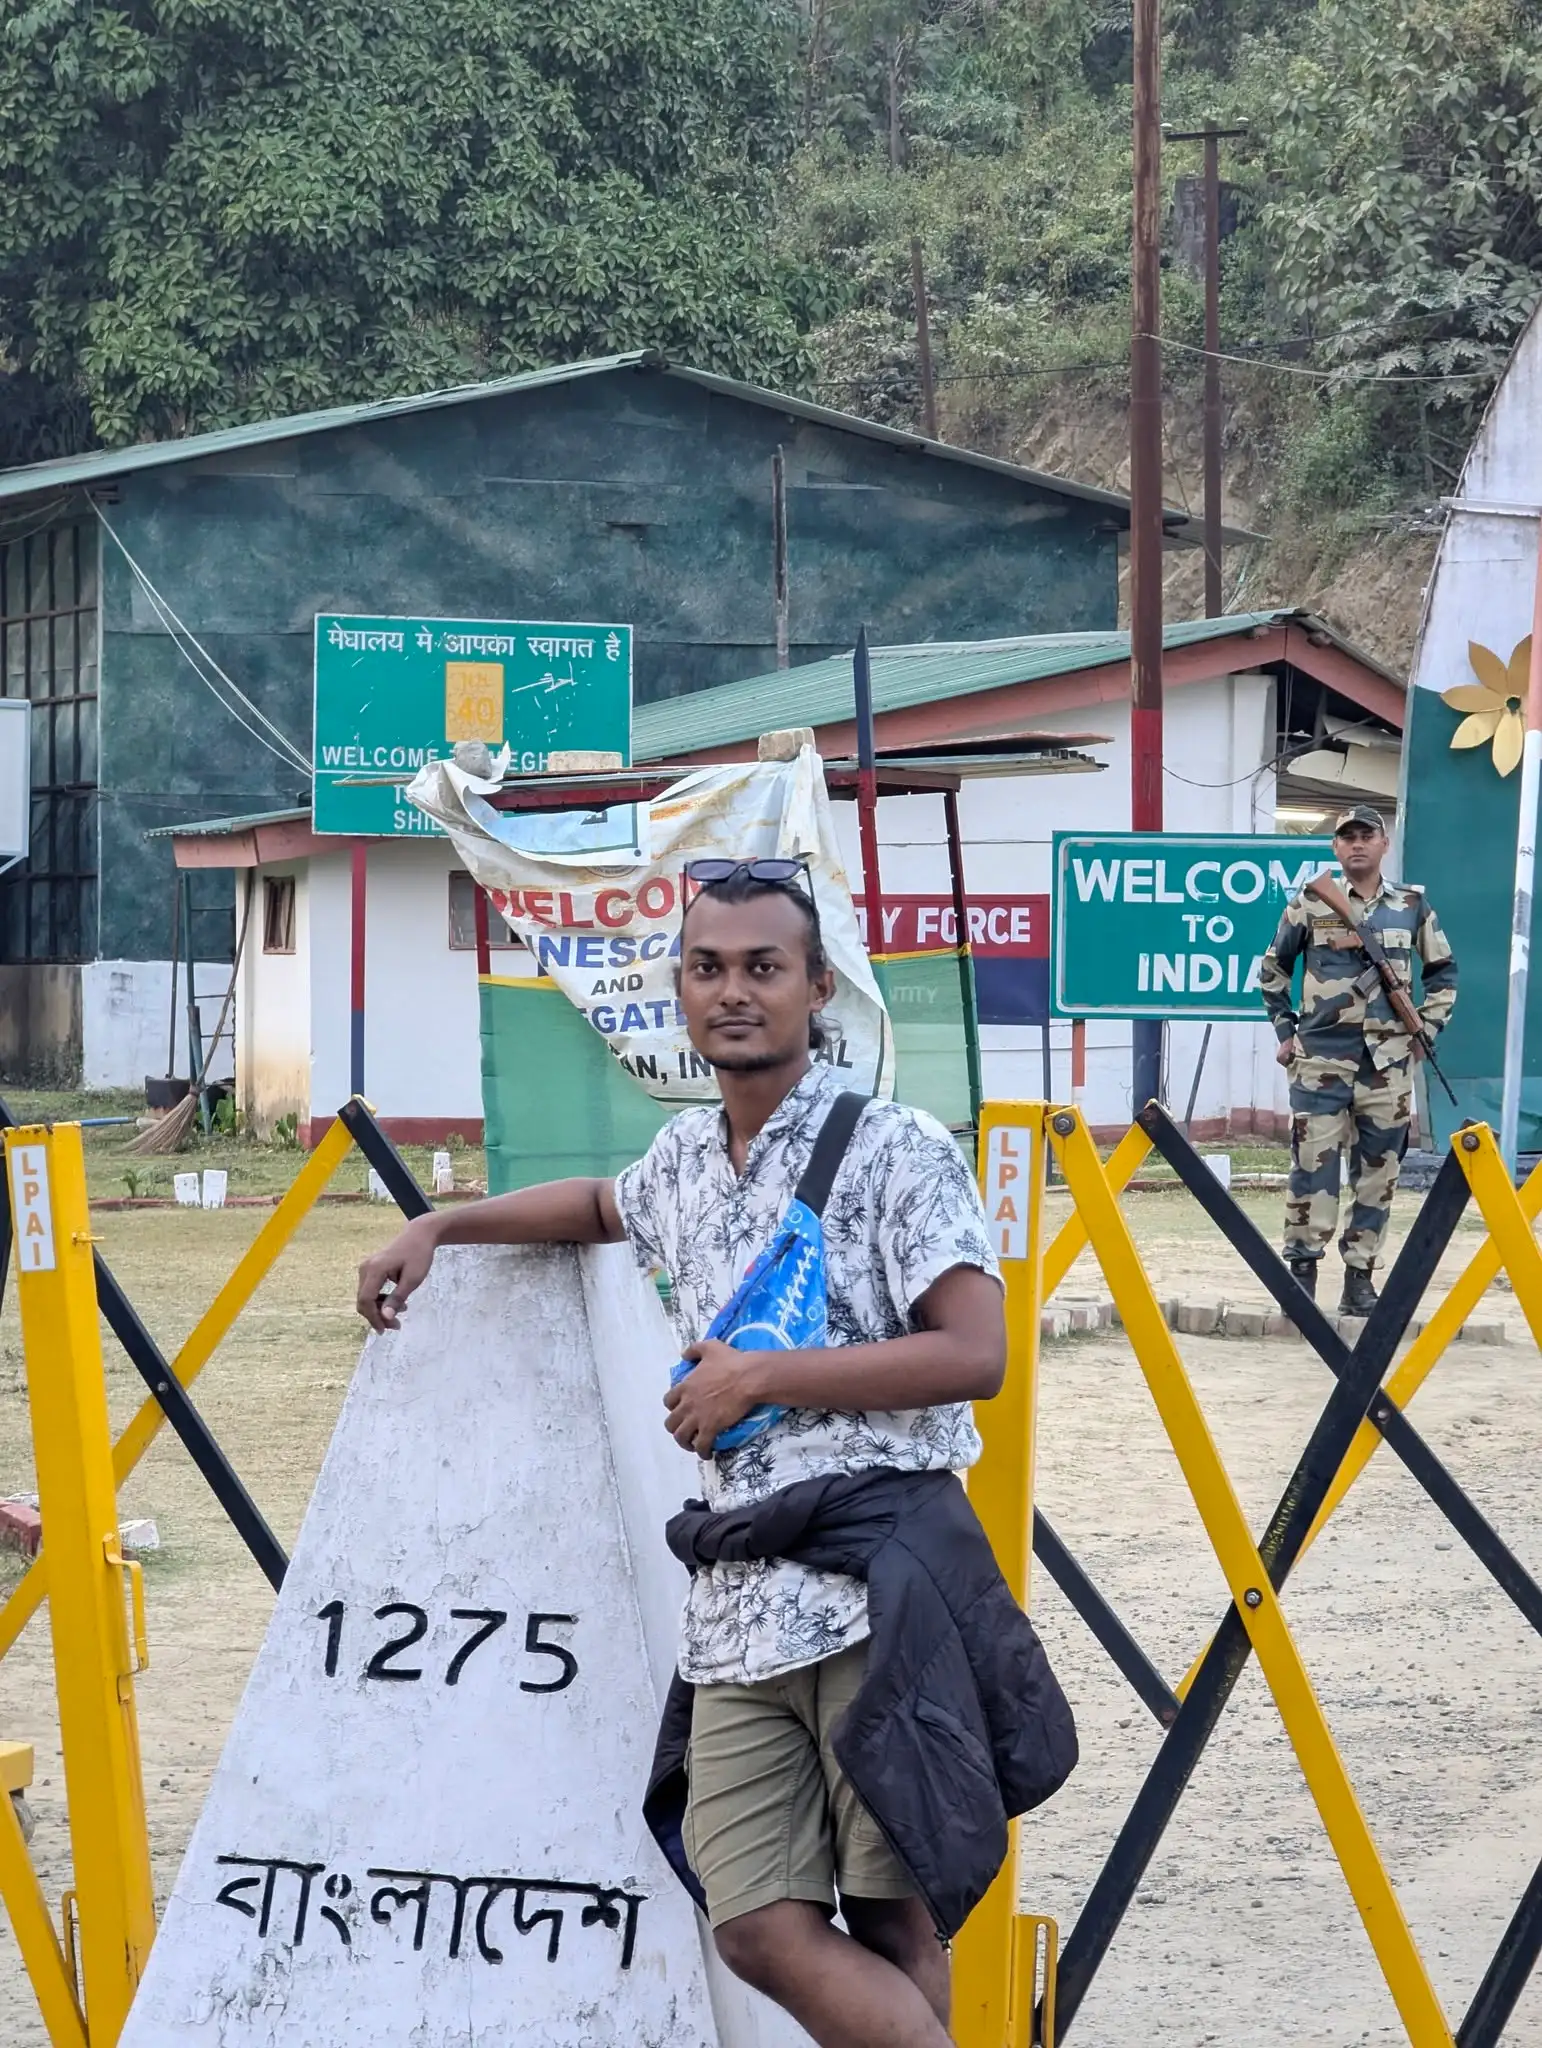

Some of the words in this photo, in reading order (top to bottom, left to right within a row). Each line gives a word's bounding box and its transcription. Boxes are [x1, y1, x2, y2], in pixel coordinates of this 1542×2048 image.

[527, 636, 596, 662] स्वागत
[605, 631, 622, 661] है
[393, 810, 442, 831] SHIL
[916, 907, 1031, 943] FORCE
[1181, 914, 1234, 943] TO
[590, 973, 644, 996] AND
[21, 1152, 45, 1266] LPAI
[995, 1131, 1019, 1255] LPAI
[318, 1599, 580, 1694] 1275
[214, 1855, 650, 1970] বাংলাদেশ
